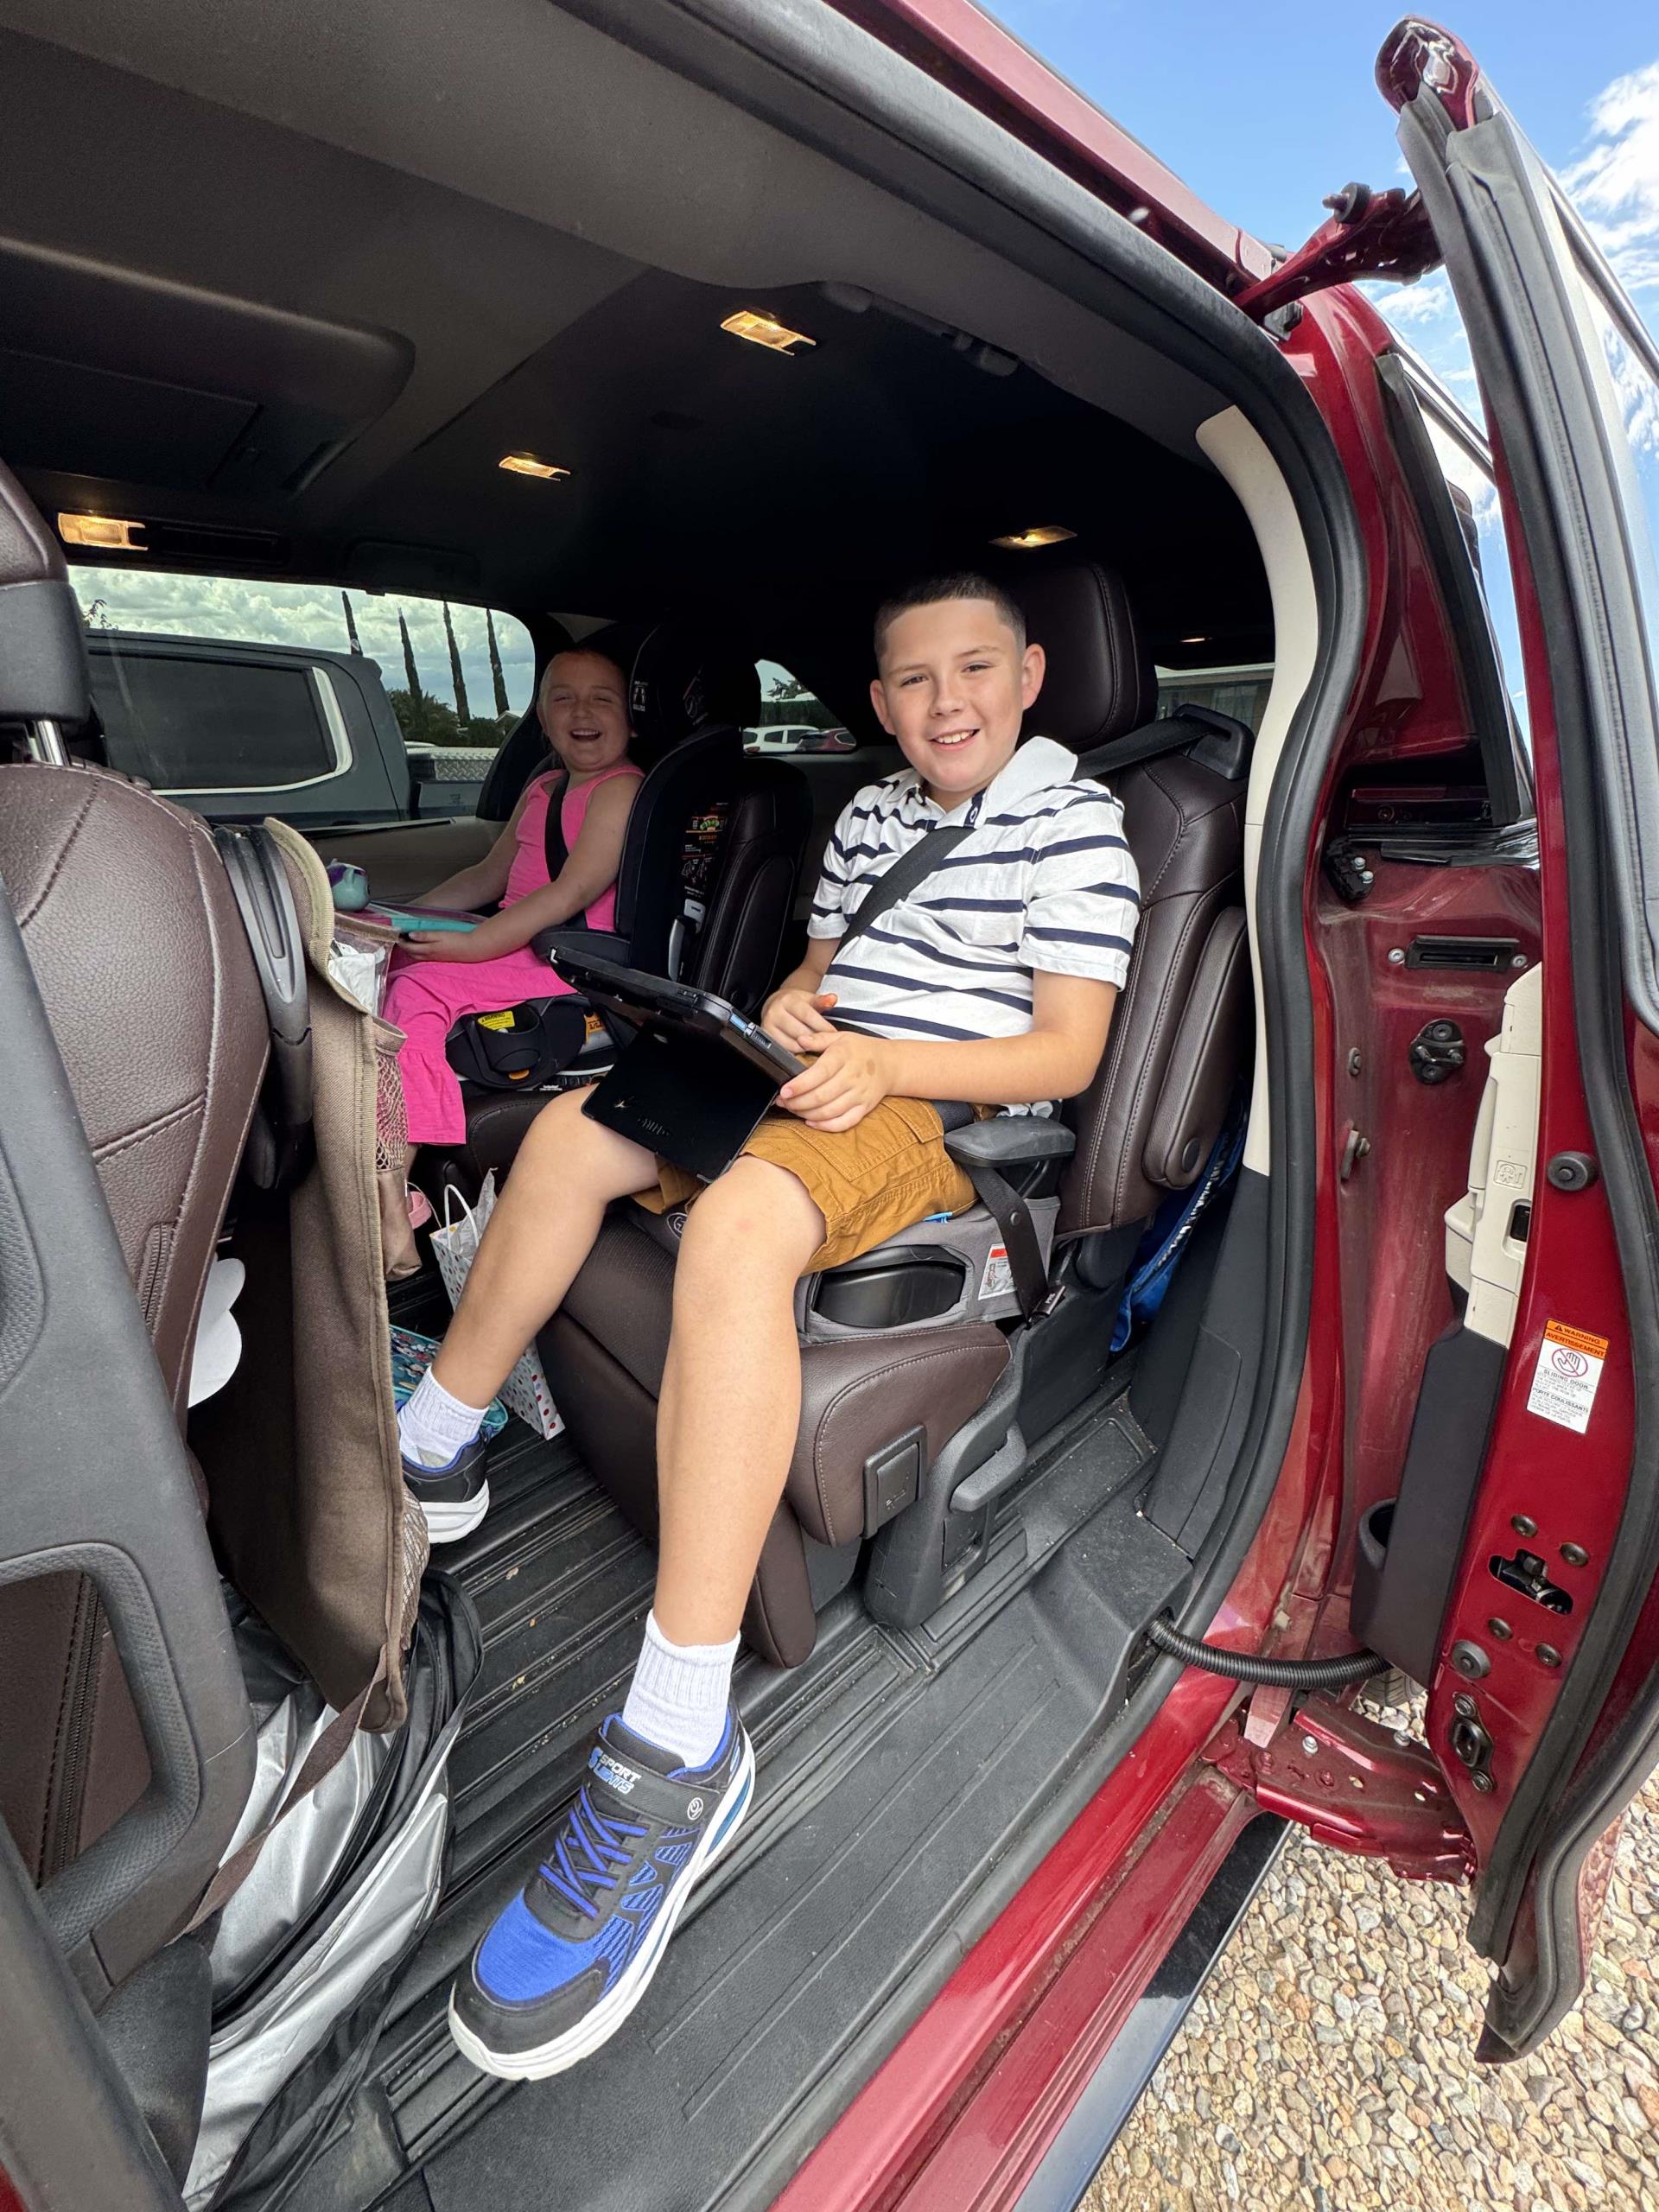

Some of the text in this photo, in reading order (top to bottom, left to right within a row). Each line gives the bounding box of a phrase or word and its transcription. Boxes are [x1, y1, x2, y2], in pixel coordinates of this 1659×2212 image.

[1547, 1332, 1605, 1357] AVERTISSEMENT
[1564, 1328, 1600, 1344] WARNING
[600, 1753, 642, 1783] SPORT
